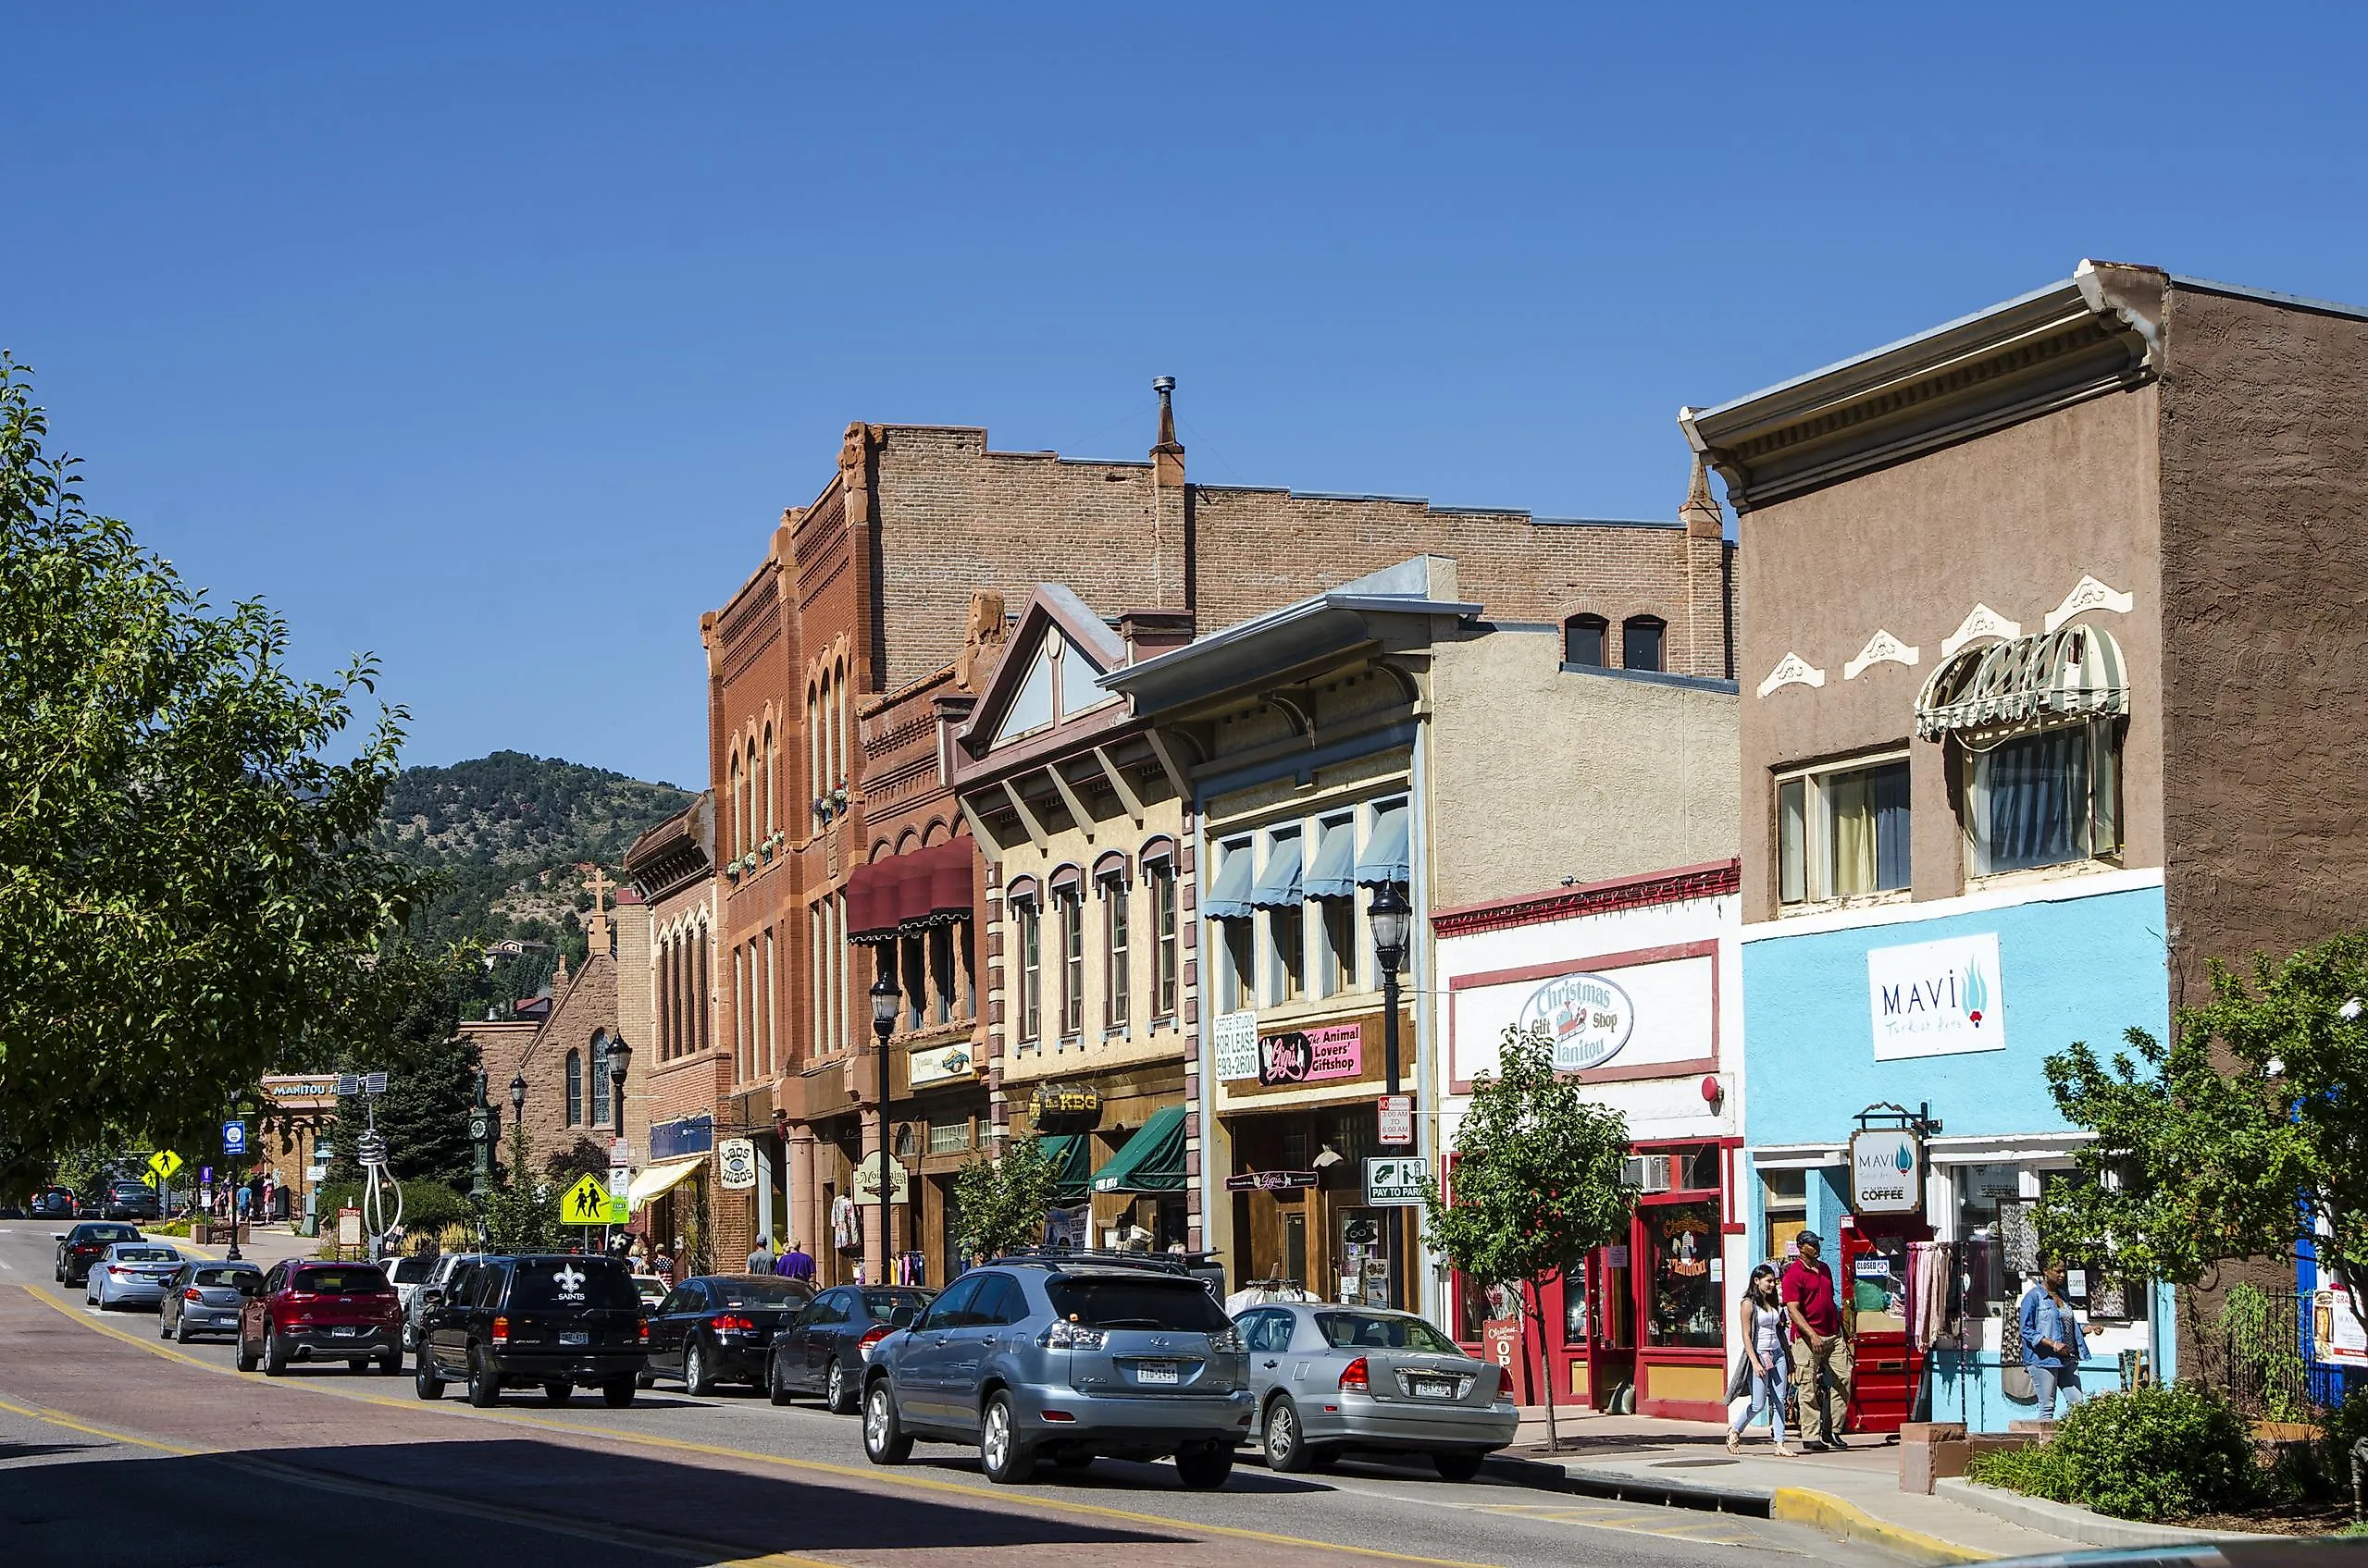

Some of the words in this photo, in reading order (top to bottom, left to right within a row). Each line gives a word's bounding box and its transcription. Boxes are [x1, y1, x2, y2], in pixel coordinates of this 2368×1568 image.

[1536, 980, 1611, 1017] Christmas
[1593, 1012, 1618, 1033] Shop
[1322, 1027, 1359, 1043] Animal
[1216, 1034, 1230, 1056] FOR
[1232, 1031, 1256, 1054] LEASE
[1314, 1043, 1351, 1058] Lovers'
[1217, 1055, 1257, 1077] 593-2600
[1312, 1058, 1355, 1073] Giftshop
[273, 1084, 326, 1095] MANITOU
[1060, 1094, 1097, 1111] KEG
[1380, 1099, 1388, 1110] NO
[721, 1147, 750, 1161] taos
[722, 1168, 754, 1184] maos
[1372, 1188, 1388, 1197] PAY
[1389, 1188, 1401, 1197] TO
[1861, 1190, 1903, 1201] COFFEE
[1856, 1262, 1877, 1270] CLOSED
